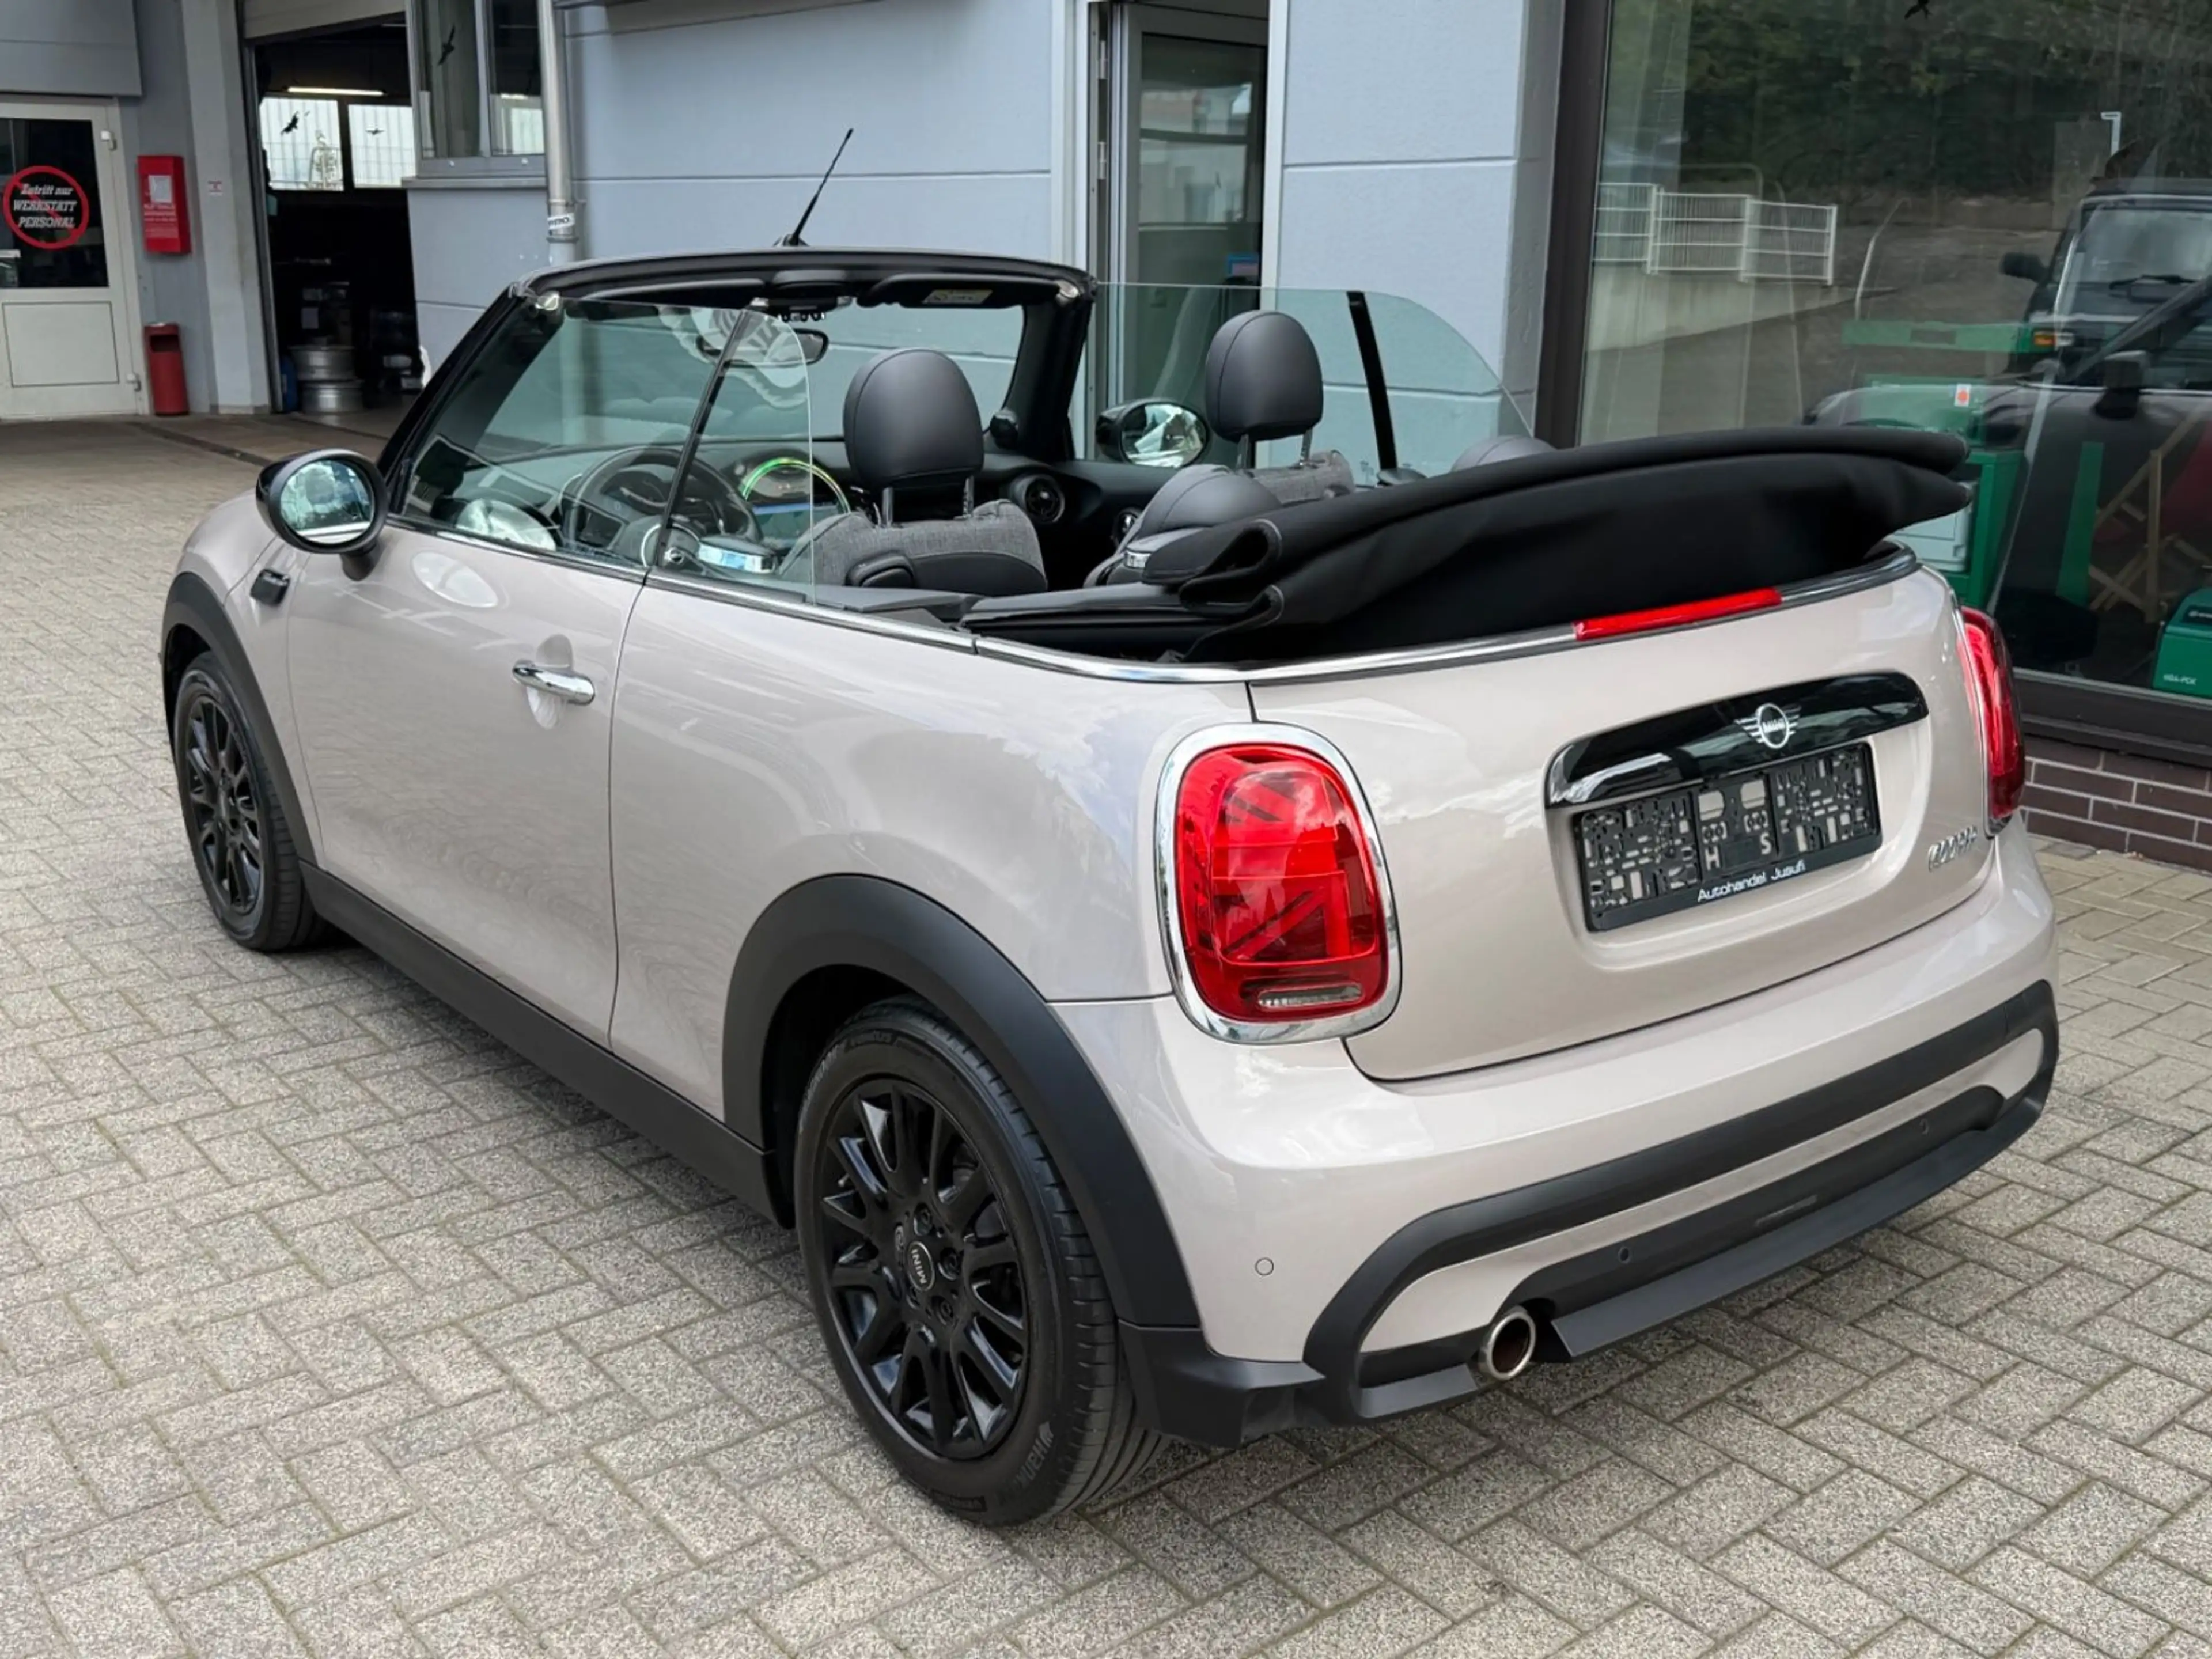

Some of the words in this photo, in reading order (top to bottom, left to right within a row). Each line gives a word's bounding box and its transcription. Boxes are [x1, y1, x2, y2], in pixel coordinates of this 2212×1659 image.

[13, 199, 78, 211] WERKSTATT
[18, 217, 75, 228] PERSONAL
[1698, 872, 1767, 902] Autohandel
[911, 1249, 927, 1284] MINI
